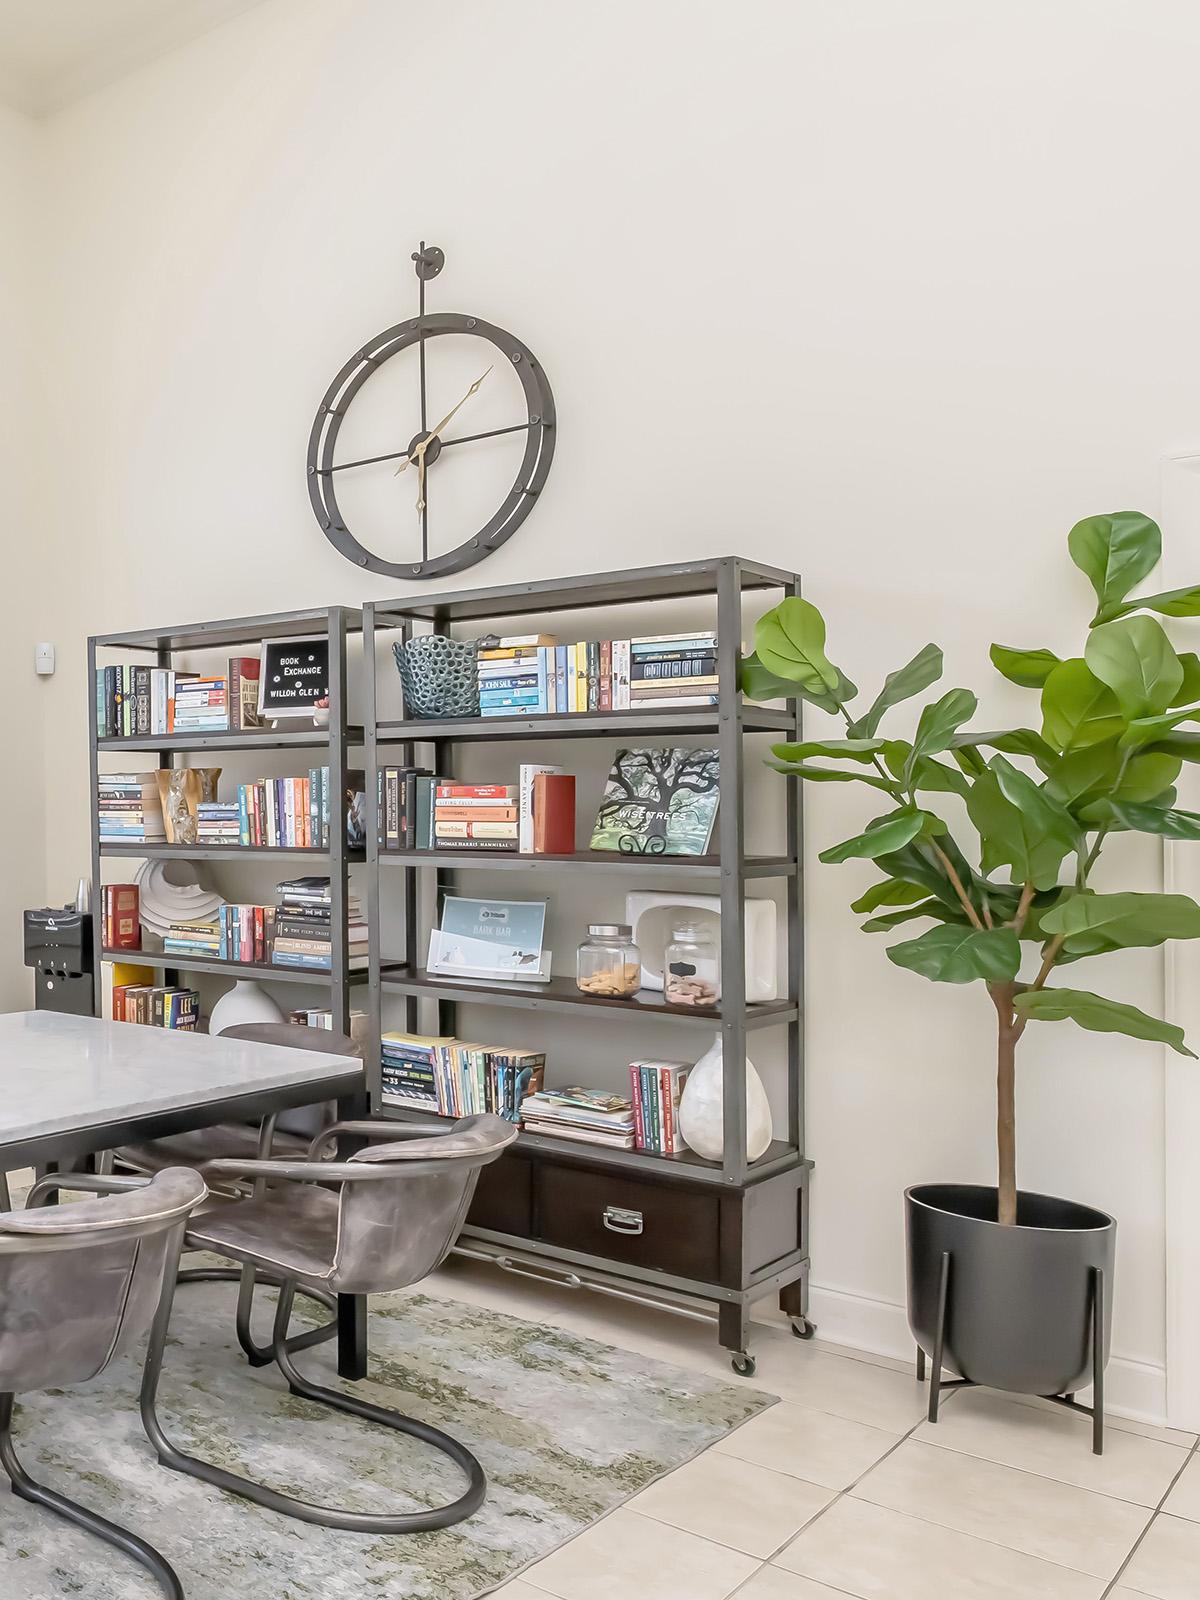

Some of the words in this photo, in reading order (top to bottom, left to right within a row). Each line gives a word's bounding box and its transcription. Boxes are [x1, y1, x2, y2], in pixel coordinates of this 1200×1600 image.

[280, 658, 300, 666] BOOK
[284, 666, 322, 676] EXCHANGE
[299, 688, 320, 696] GLEN
[620, 810, 644, 819] WISE
[650, 811, 687, 820] TREES
[473, 925, 492, 935] BARK
[496, 926, 511, 936] BAR
[180, 998, 191, 1014] LEE
